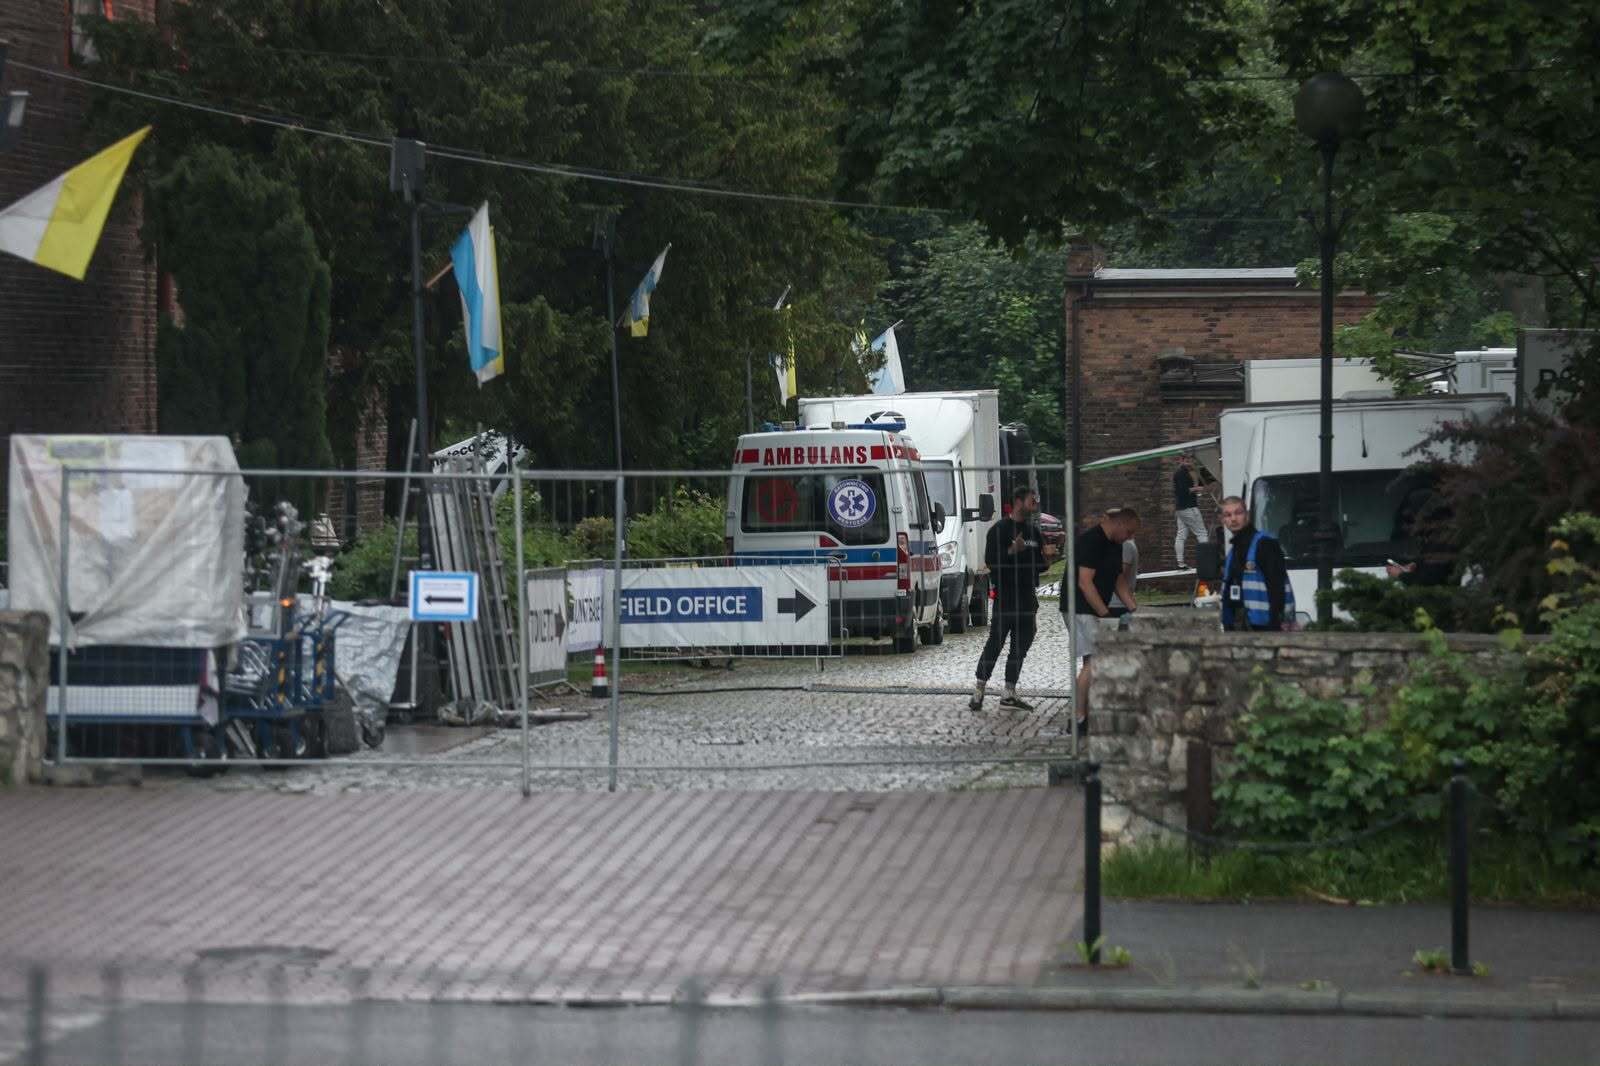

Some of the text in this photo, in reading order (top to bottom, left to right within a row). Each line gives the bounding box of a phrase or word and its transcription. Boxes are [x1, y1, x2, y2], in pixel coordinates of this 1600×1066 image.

[763, 446, 867, 465] AMBULANS
[619, 595, 747, 616] FIELD OFFICE
